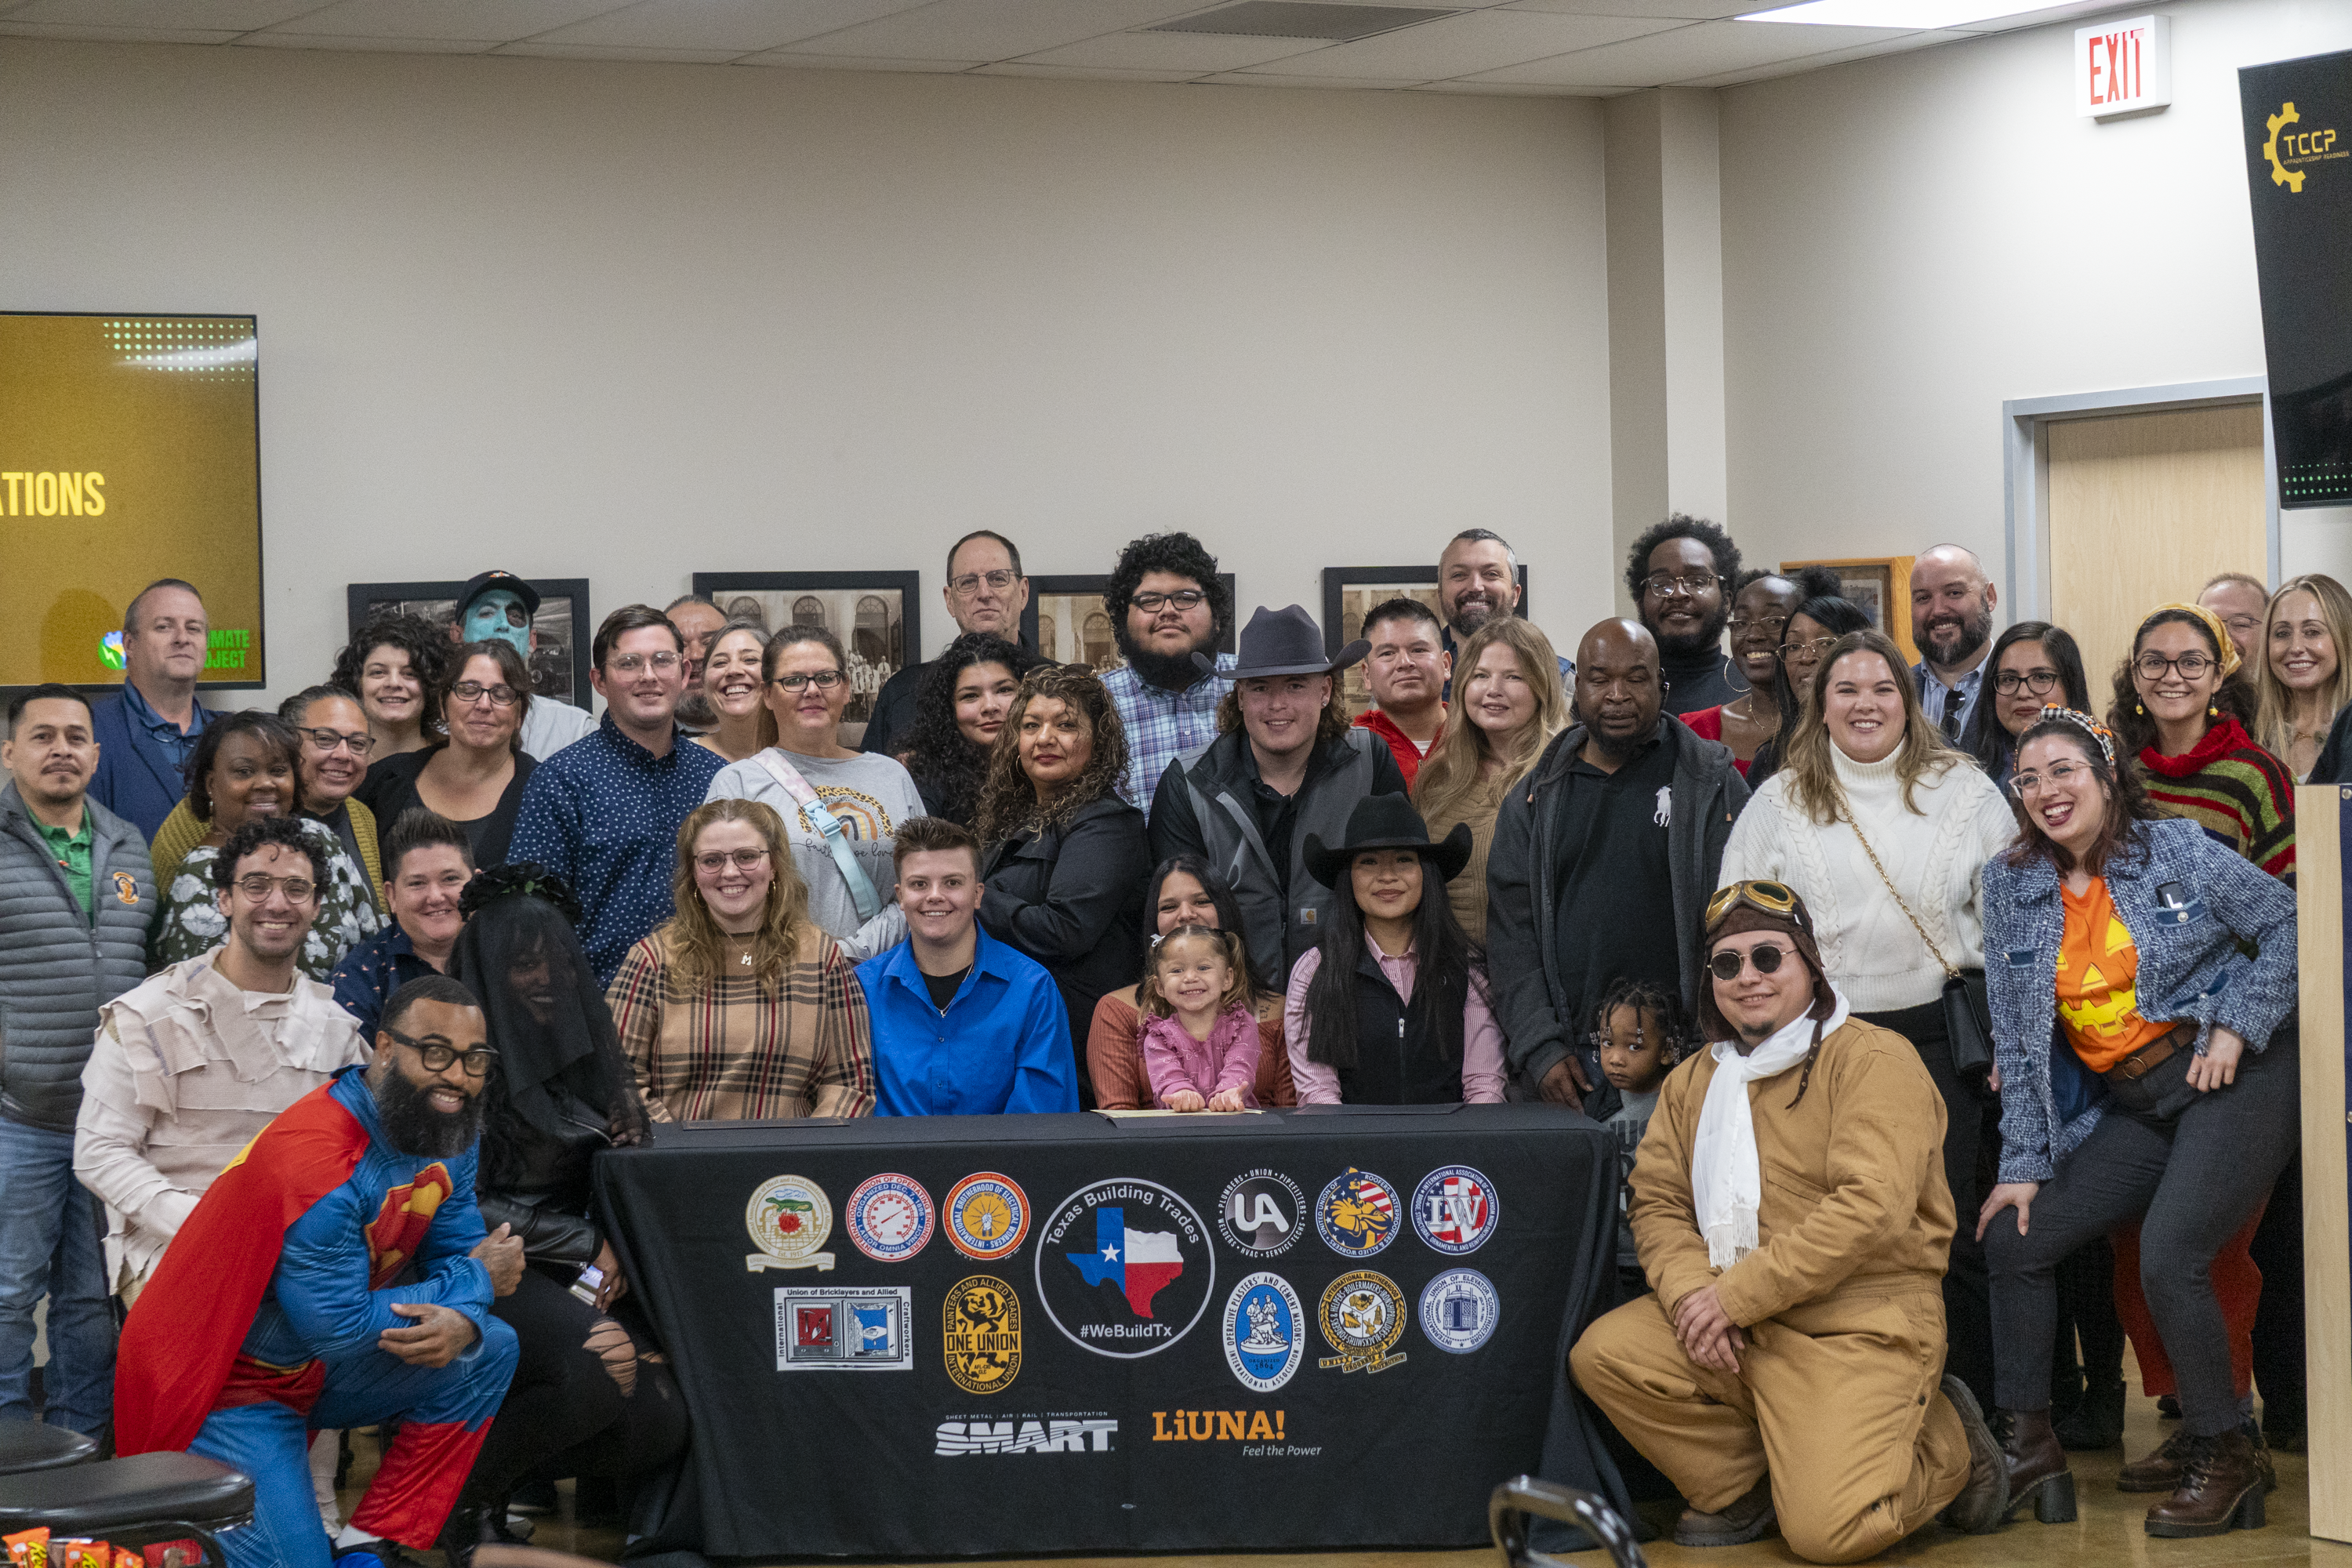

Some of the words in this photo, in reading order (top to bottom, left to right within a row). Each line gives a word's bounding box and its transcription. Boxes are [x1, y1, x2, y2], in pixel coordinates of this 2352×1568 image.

[2089, 28, 2144, 105] EXIT
[2283, 129, 2336, 156] TCCP
[0, 472, 105, 516] TIONS
[204, 650, 246, 669] OJECT
[859, 1178, 881, 1195] UNION
[896, 1178, 930, 1210] OPERATING
[995, 1185, 1004, 1194] OF
[1218, 1174, 1243, 1208] PLUMBERS
[1250, 1168, 1272, 1177] UNION
[1279, 1174, 1307, 1214] PIPEFITTERS
[1423, 1170, 1454, 1190] INTERNATIONAL
[1456, 1169, 1483, 1183] ASSOCIATION
[856, 1183, 889, 1217] ORGANIZED
[891, 1184, 908, 1194] DEC.
[915, 1199, 925, 1216] 1896
[956, 1184, 993, 1209] BROTHERHOOD
[1002, 1190, 1019, 1224] ELECTRICAL
[1235, 1193, 1289, 1232] UA
[1319, 1190, 1331, 1210] UNION
[1428, 1196, 1483, 1227] IW
[850, 1196, 873, 1252] INTERNATIONAL
[954, 1211, 985, 1248] INTERNATIONAL
[1047, 1204, 1083, 1244] Texas
[1083, 1185, 1154, 1207] Building
[1159, 1195, 1199, 1243] Trades
[1317, 1212, 1327, 1236] UNITED
[1383, 1192, 1399, 1243] WATERPROOFERS
[1430, 1236, 1458, 1251] ORNAMENTAL
[1469, 1226, 1490, 1248] REINFORCING
[1487, 1192, 1496, 1214] WORKERS
[858, 1225, 878, 1247] LABOR
[906, 1224, 924, 1246] VINCIT
[909, 1212, 931, 1252] ENGINEERS
[990, 1225, 1017, 1248] WORKERS
[1218, 1218, 1237, 1247] WELDERS
[1240, 1247, 1258, 1258] HVAC
[1265, 1241, 1293, 1258] SERVICE
[1291, 1223, 1305, 1243] TECHS
[1329, 1239, 1357, 1255] WORKERS
[1359, 1245, 1378, 1255] ALLIED
[1326, 1273, 1363, 1299] INTERNATIONAL
[1364, 1273, 1399, 1298] BROTHERHOOD
[1429, 1279, 1446, 1297] UNION
[1463, 1275, 1490, 1294] ELEVATOR
[947, 1289, 961, 1330] PAINTERS
[960, 1279, 978, 1292] AND
[980, 1279, 1008, 1295] ALLIED
[1007, 1295, 1018, 1330] TRADES
[1226, 1308, 1236, 1345] OPERATIVE
[1264, 1276, 1279, 1287] AND
[1279, 1285, 1297, 1310] CEMENT
[1080, 1323, 1172, 1338] #WeBuildTx
[1425, 1301, 1452, 1345] INTERNATIONAL
[1471, 1298, 1494, 1345] CONSTRUCTORS
[947, 1334, 972, 1351] ONE
[978, 1334, 1018, 1351] UNION
[948, 1354, 1004, 1391] INTERNATIONAL
[1003, 1355, 1018, 1381] UNION
[1229, 1350, 1268, 1388] INTERNATIONAL
[1272, 1350, 1299, 1386] ASSOCIATION
[935, 1420, 1118, 1456] SMART
[1152, 1409, 1285, 1441] LiUNA!
[1243, 1445, 1265, 1456] Feel
[1267, 1445, 1284, 1456] the
[1287, 1446, 1322, 1456] Power
